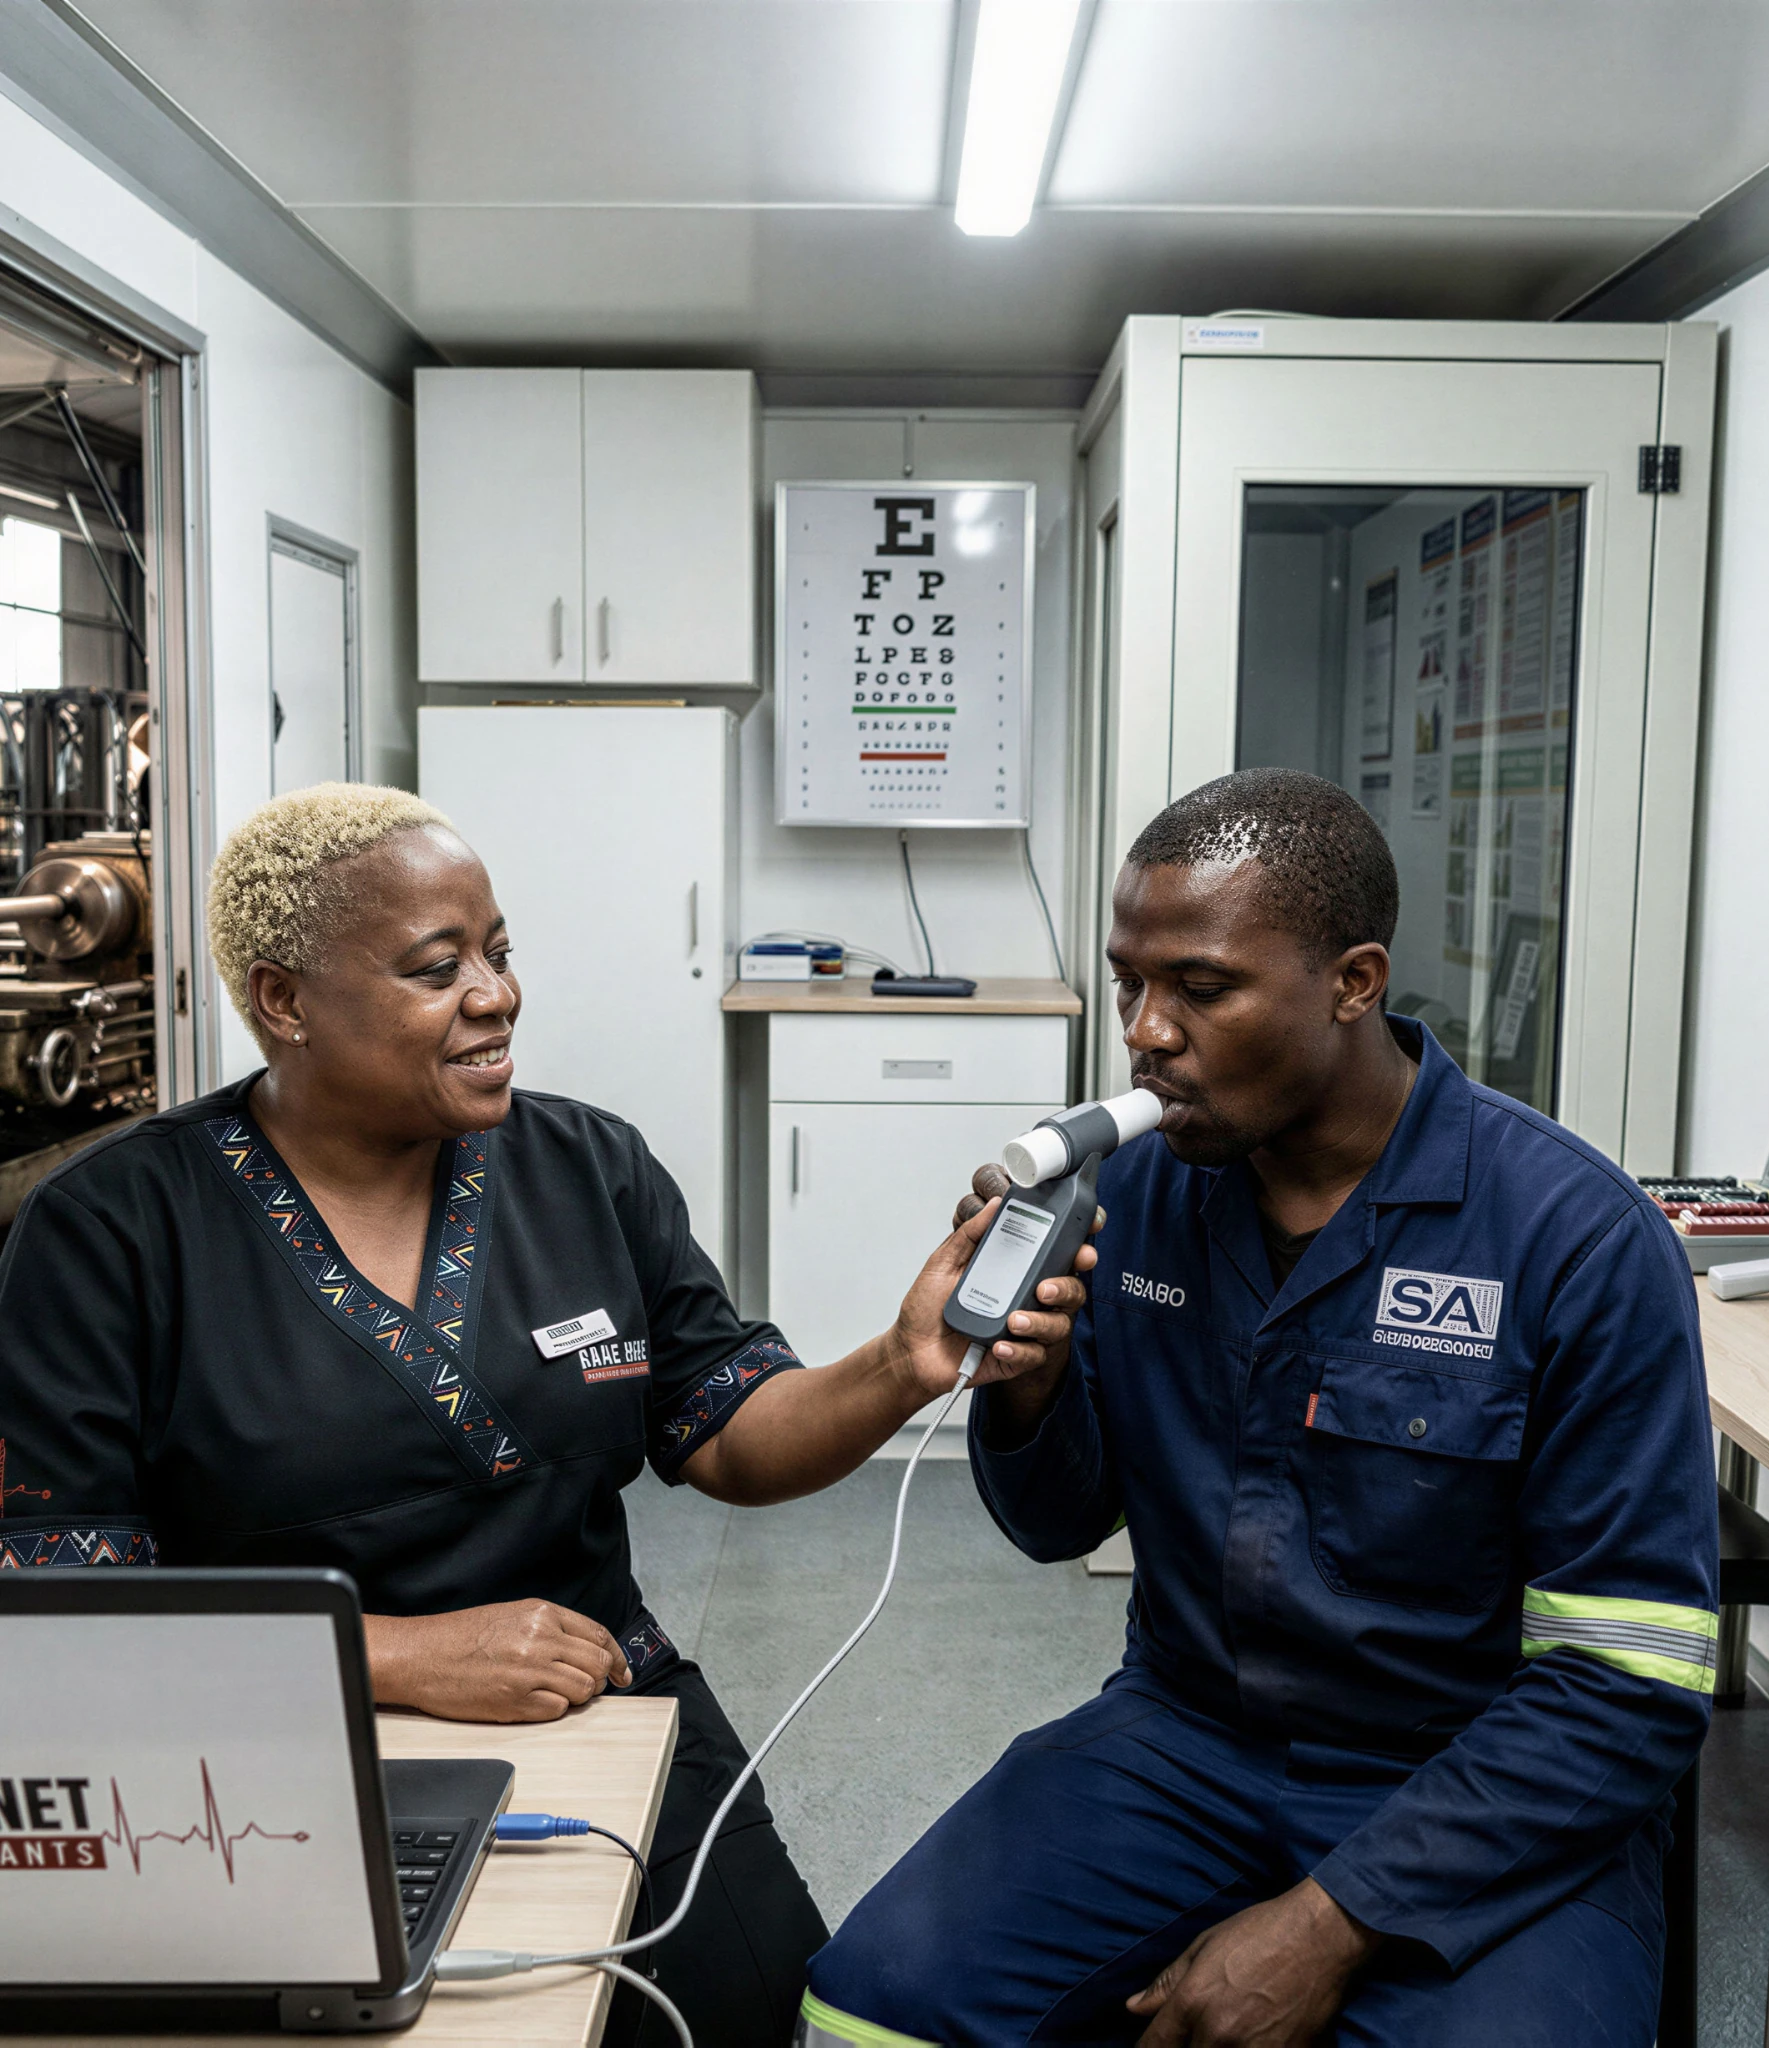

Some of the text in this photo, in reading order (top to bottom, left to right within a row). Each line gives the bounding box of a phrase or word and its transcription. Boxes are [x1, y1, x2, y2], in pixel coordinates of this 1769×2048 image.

[873, 497, 936, 558] E
[861, 569, 946, 601] F P
[1387, 1277, 1486, 1335] SA
[0, 1840, 95, 1866] ANTS
